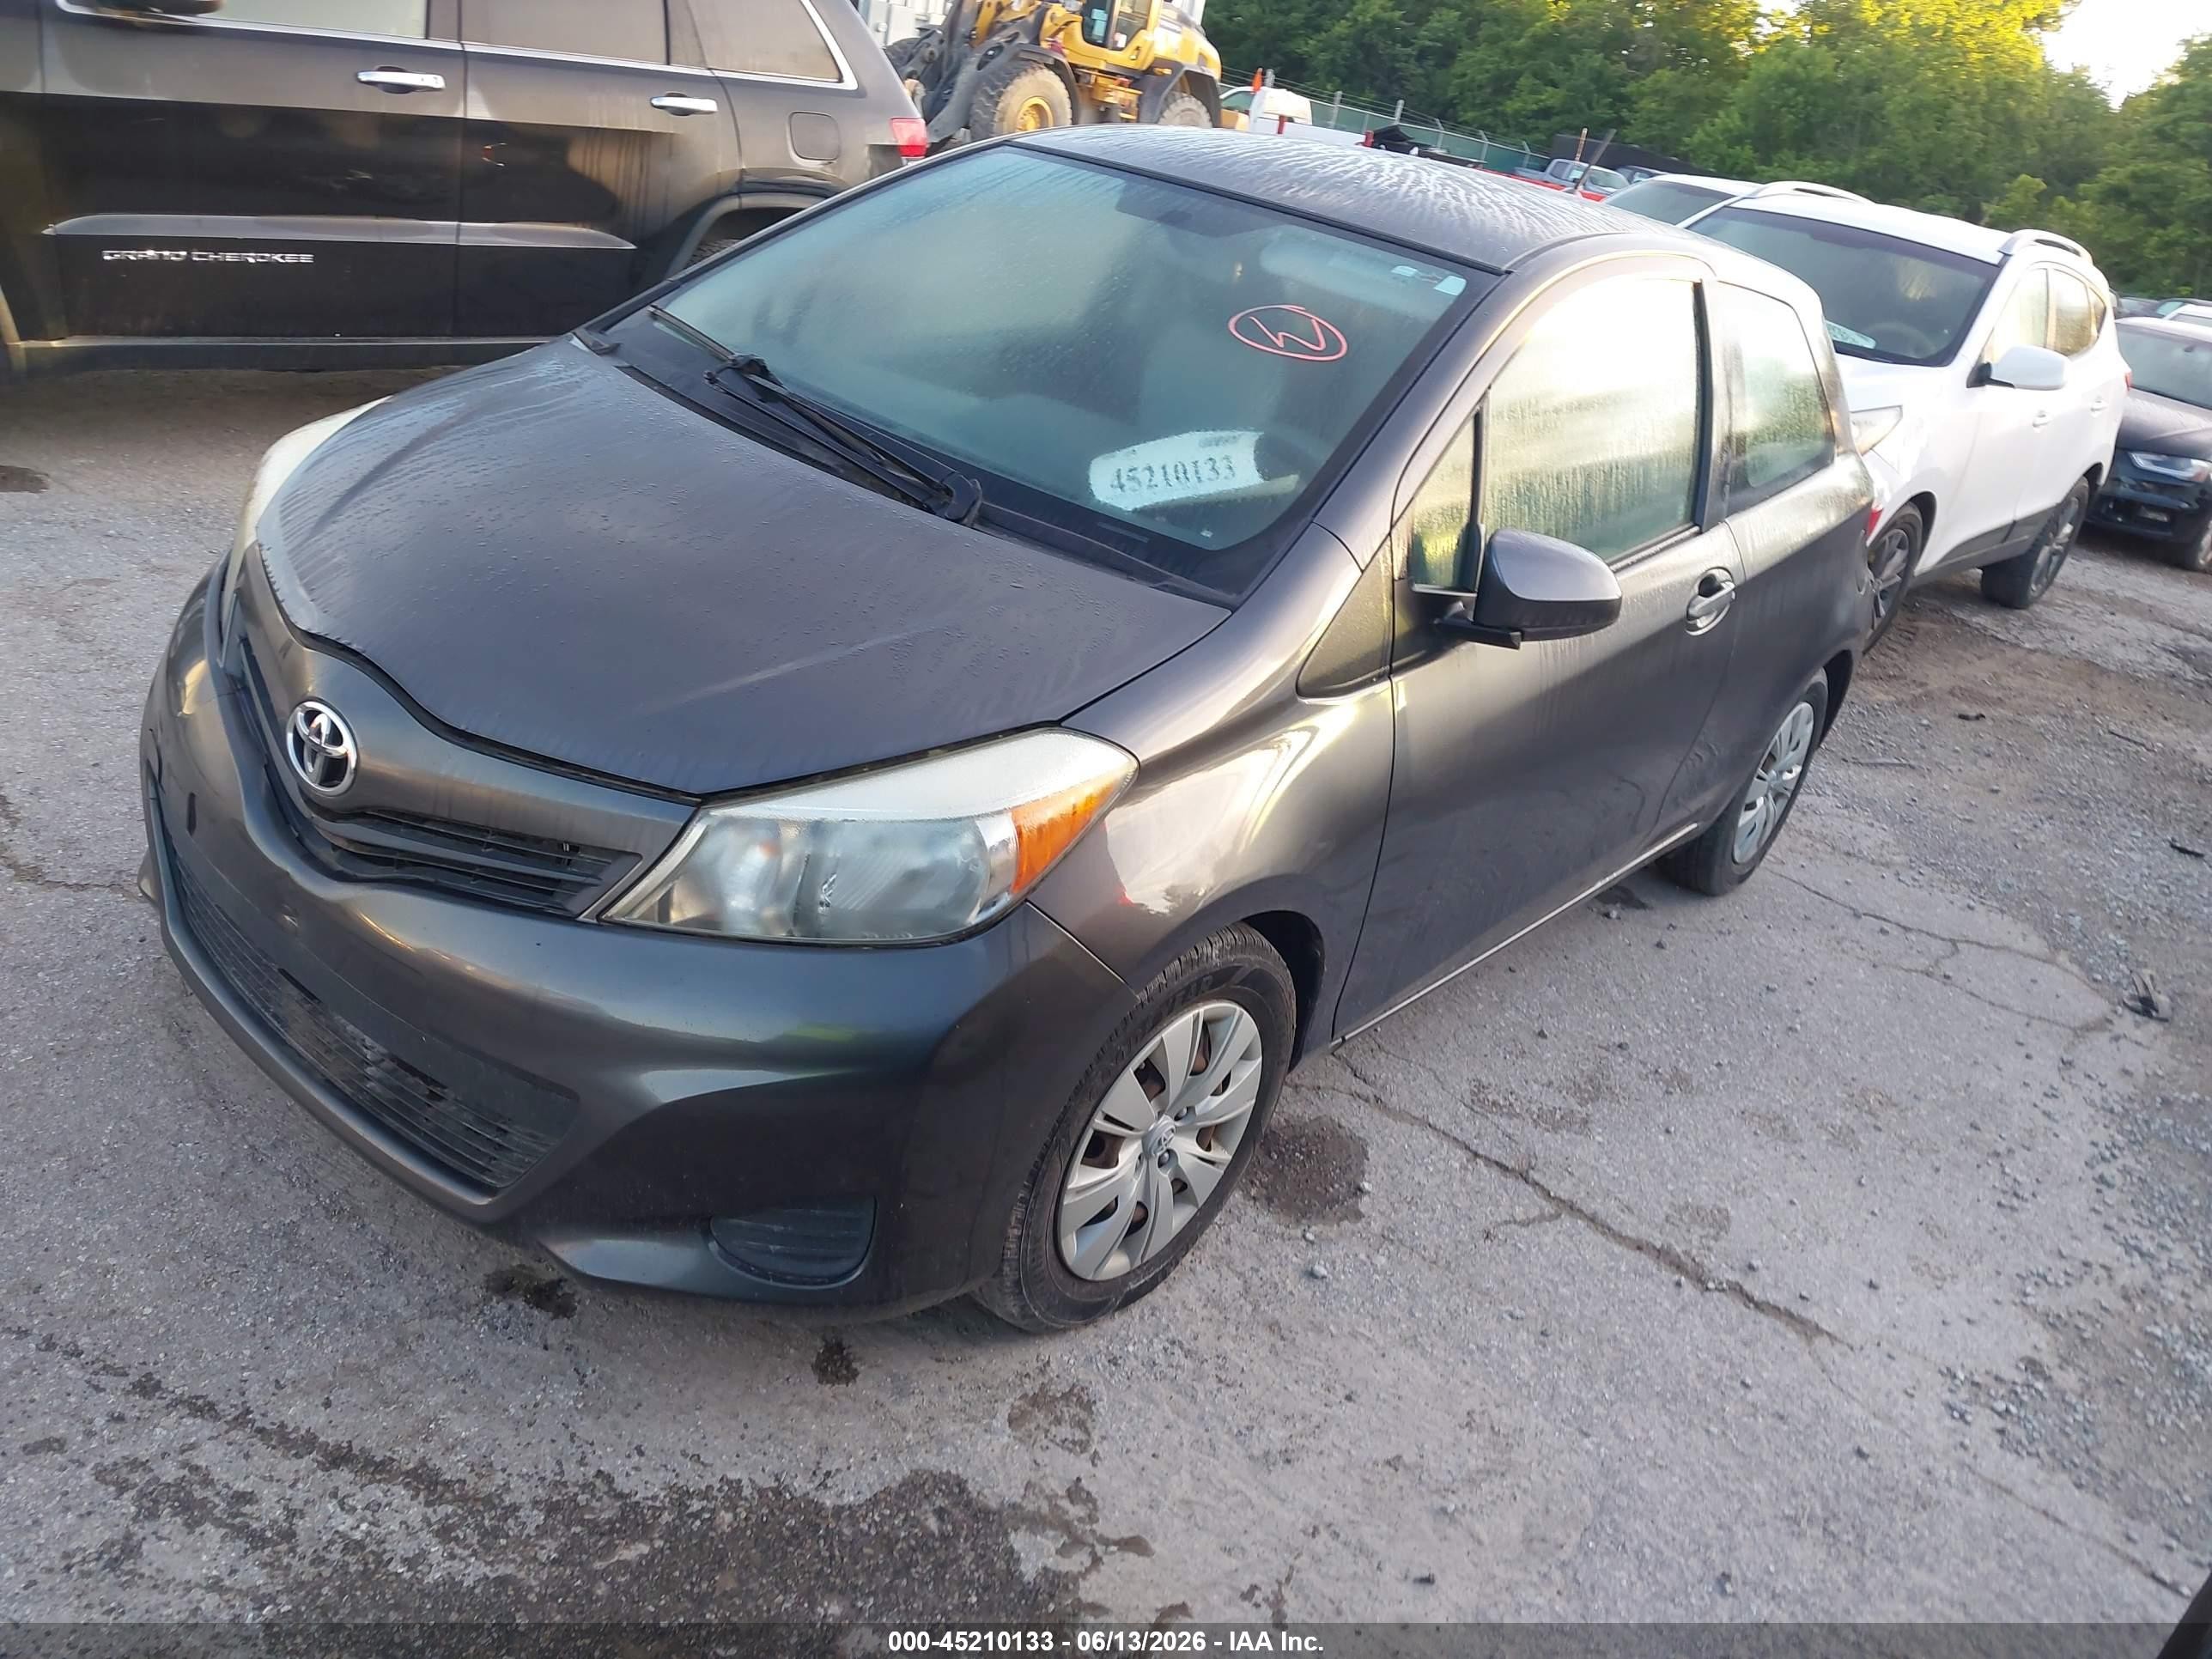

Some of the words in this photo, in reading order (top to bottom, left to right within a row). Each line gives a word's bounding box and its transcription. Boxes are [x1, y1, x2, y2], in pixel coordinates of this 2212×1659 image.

[102, 250, 187, 262] GRAND
[191, 252, 314, 263] CHEROKEE
[1109, 454, 1237, 495] 45210133
